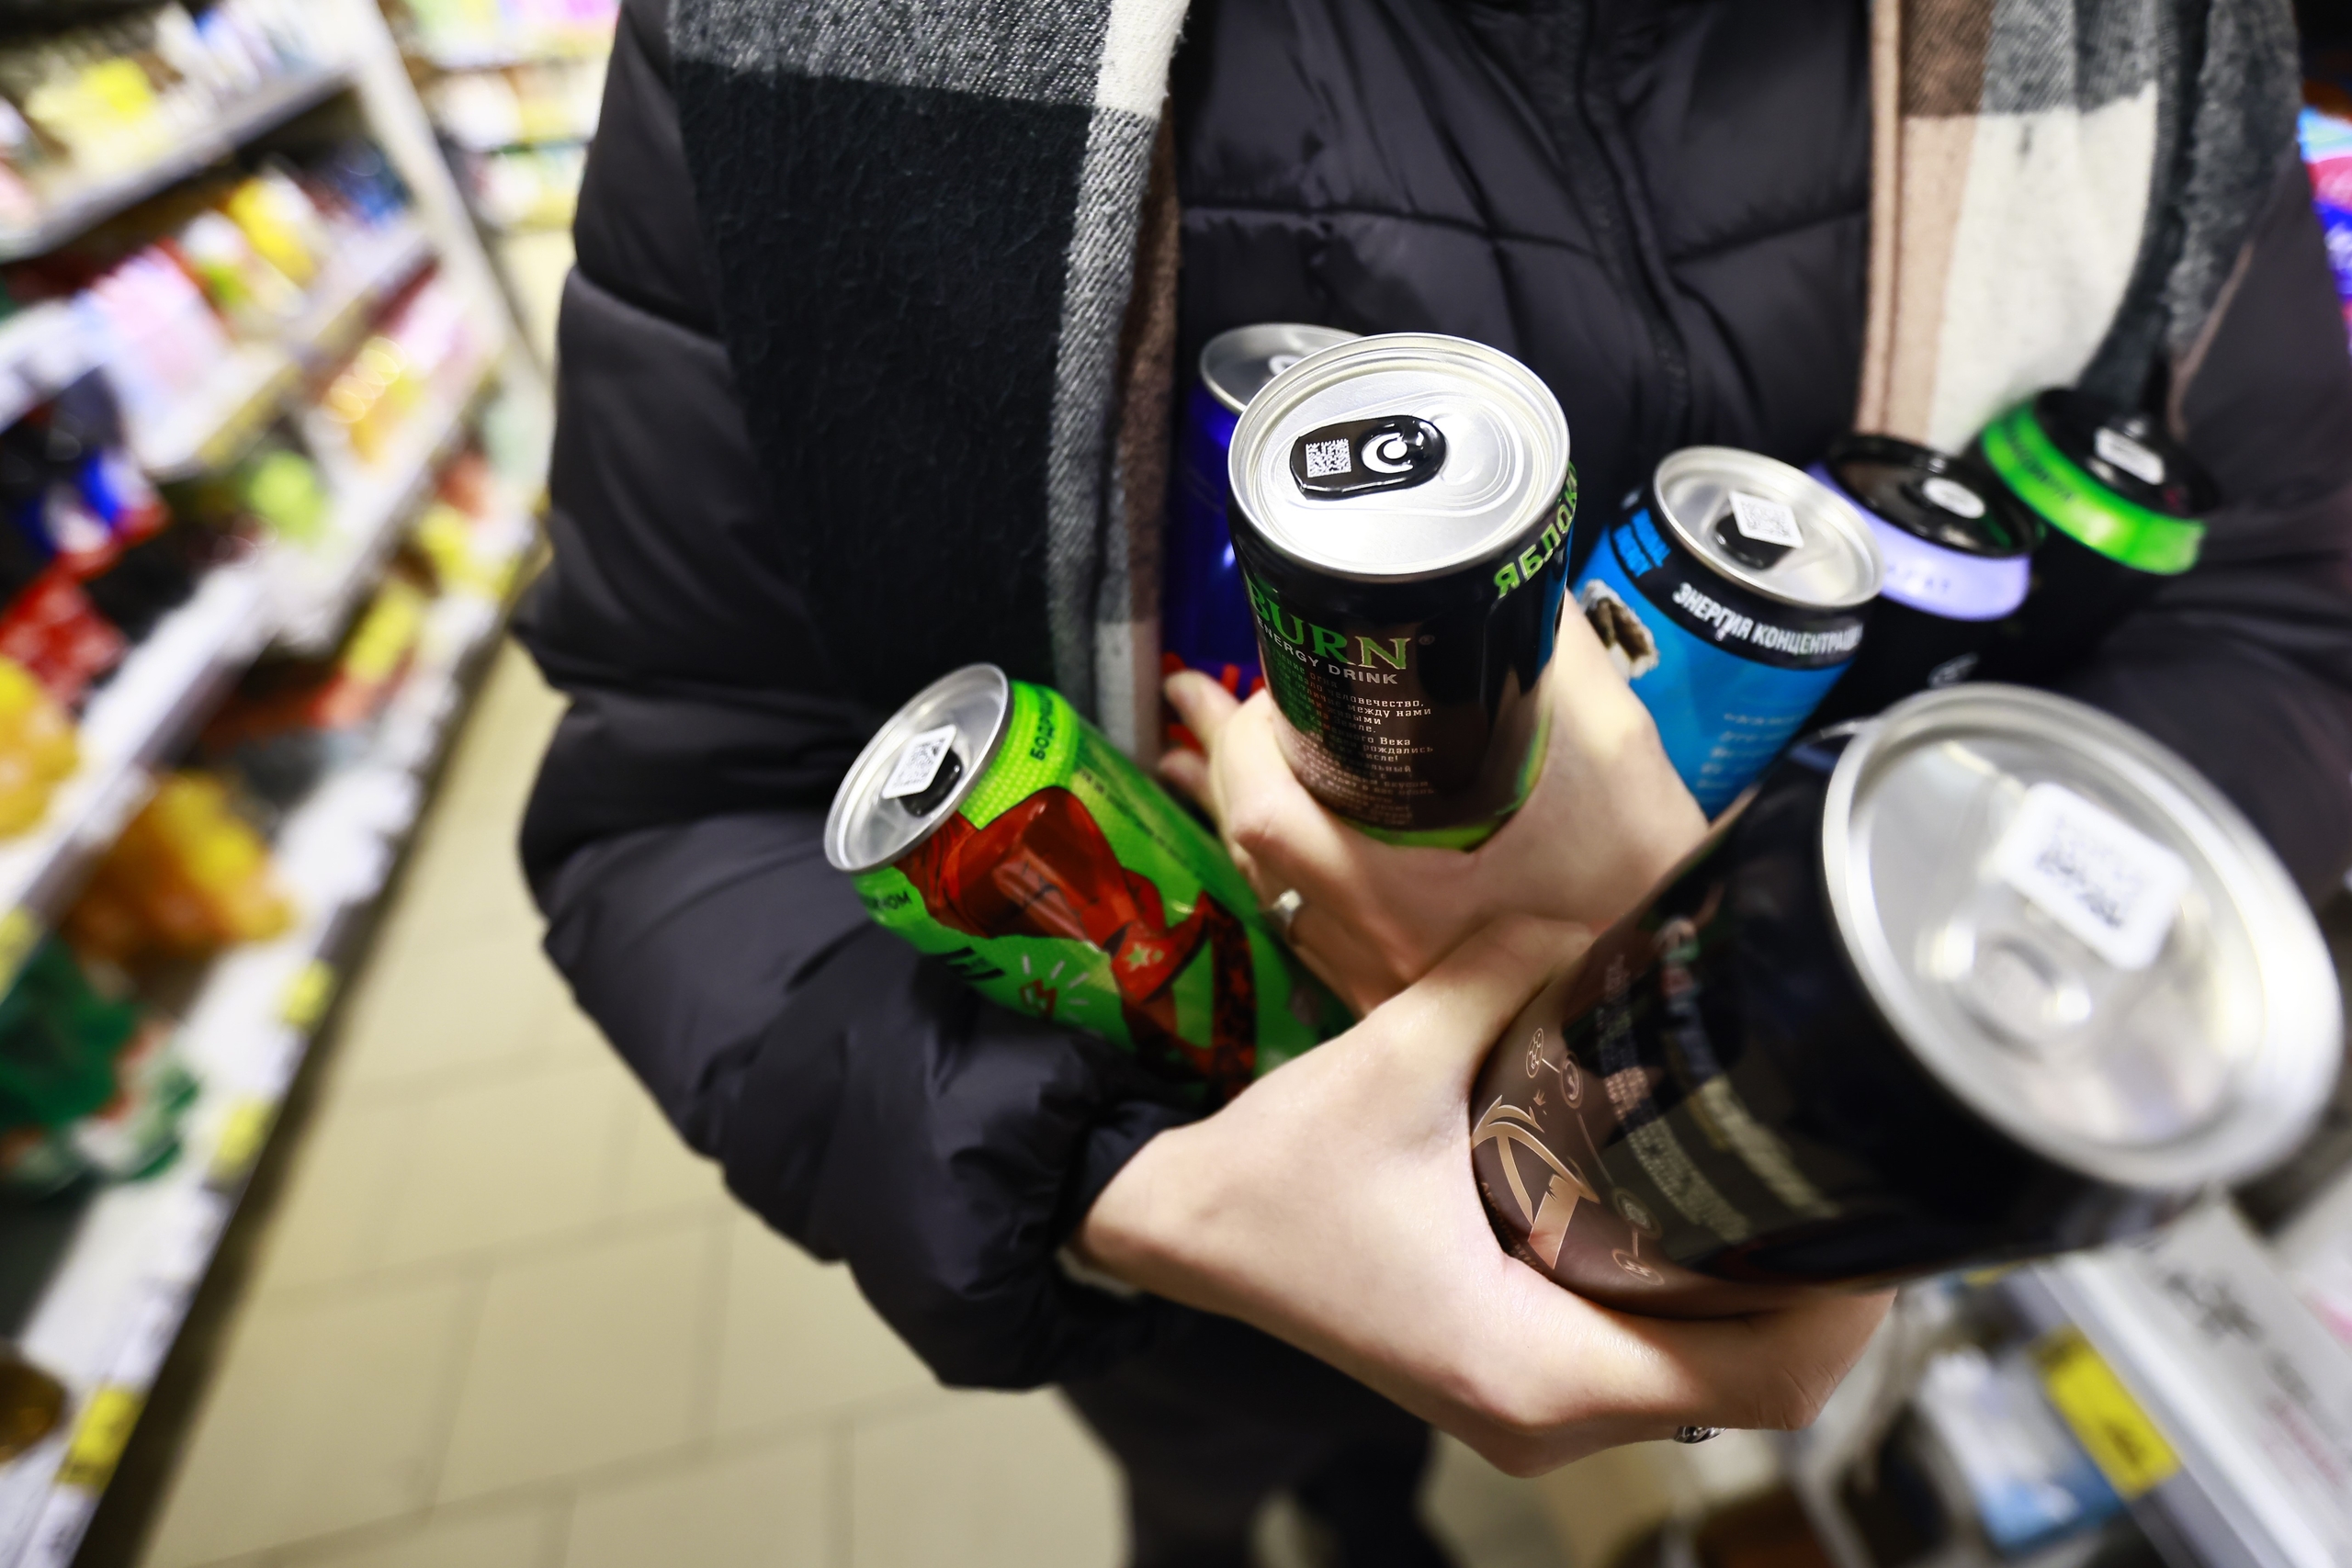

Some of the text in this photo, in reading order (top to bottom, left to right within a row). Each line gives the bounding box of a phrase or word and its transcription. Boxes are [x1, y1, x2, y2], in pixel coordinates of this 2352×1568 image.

[1672, 581, 1754, 640] ЭНЕРГИЯ
[1247, 577, 1411, 671] BURN
[1257, 615, 1398, 685] ENERGY DRINK
[1328, 689, 1424, 708] человечество.
[1328, 705, 1382, 725] живыми
[1347, 704, 1391, 718] между
[1396, 708, 1431, 717] нами
[1363, 744, 1433, 755] рождались
[1379, 736, 1411, 746] Века
